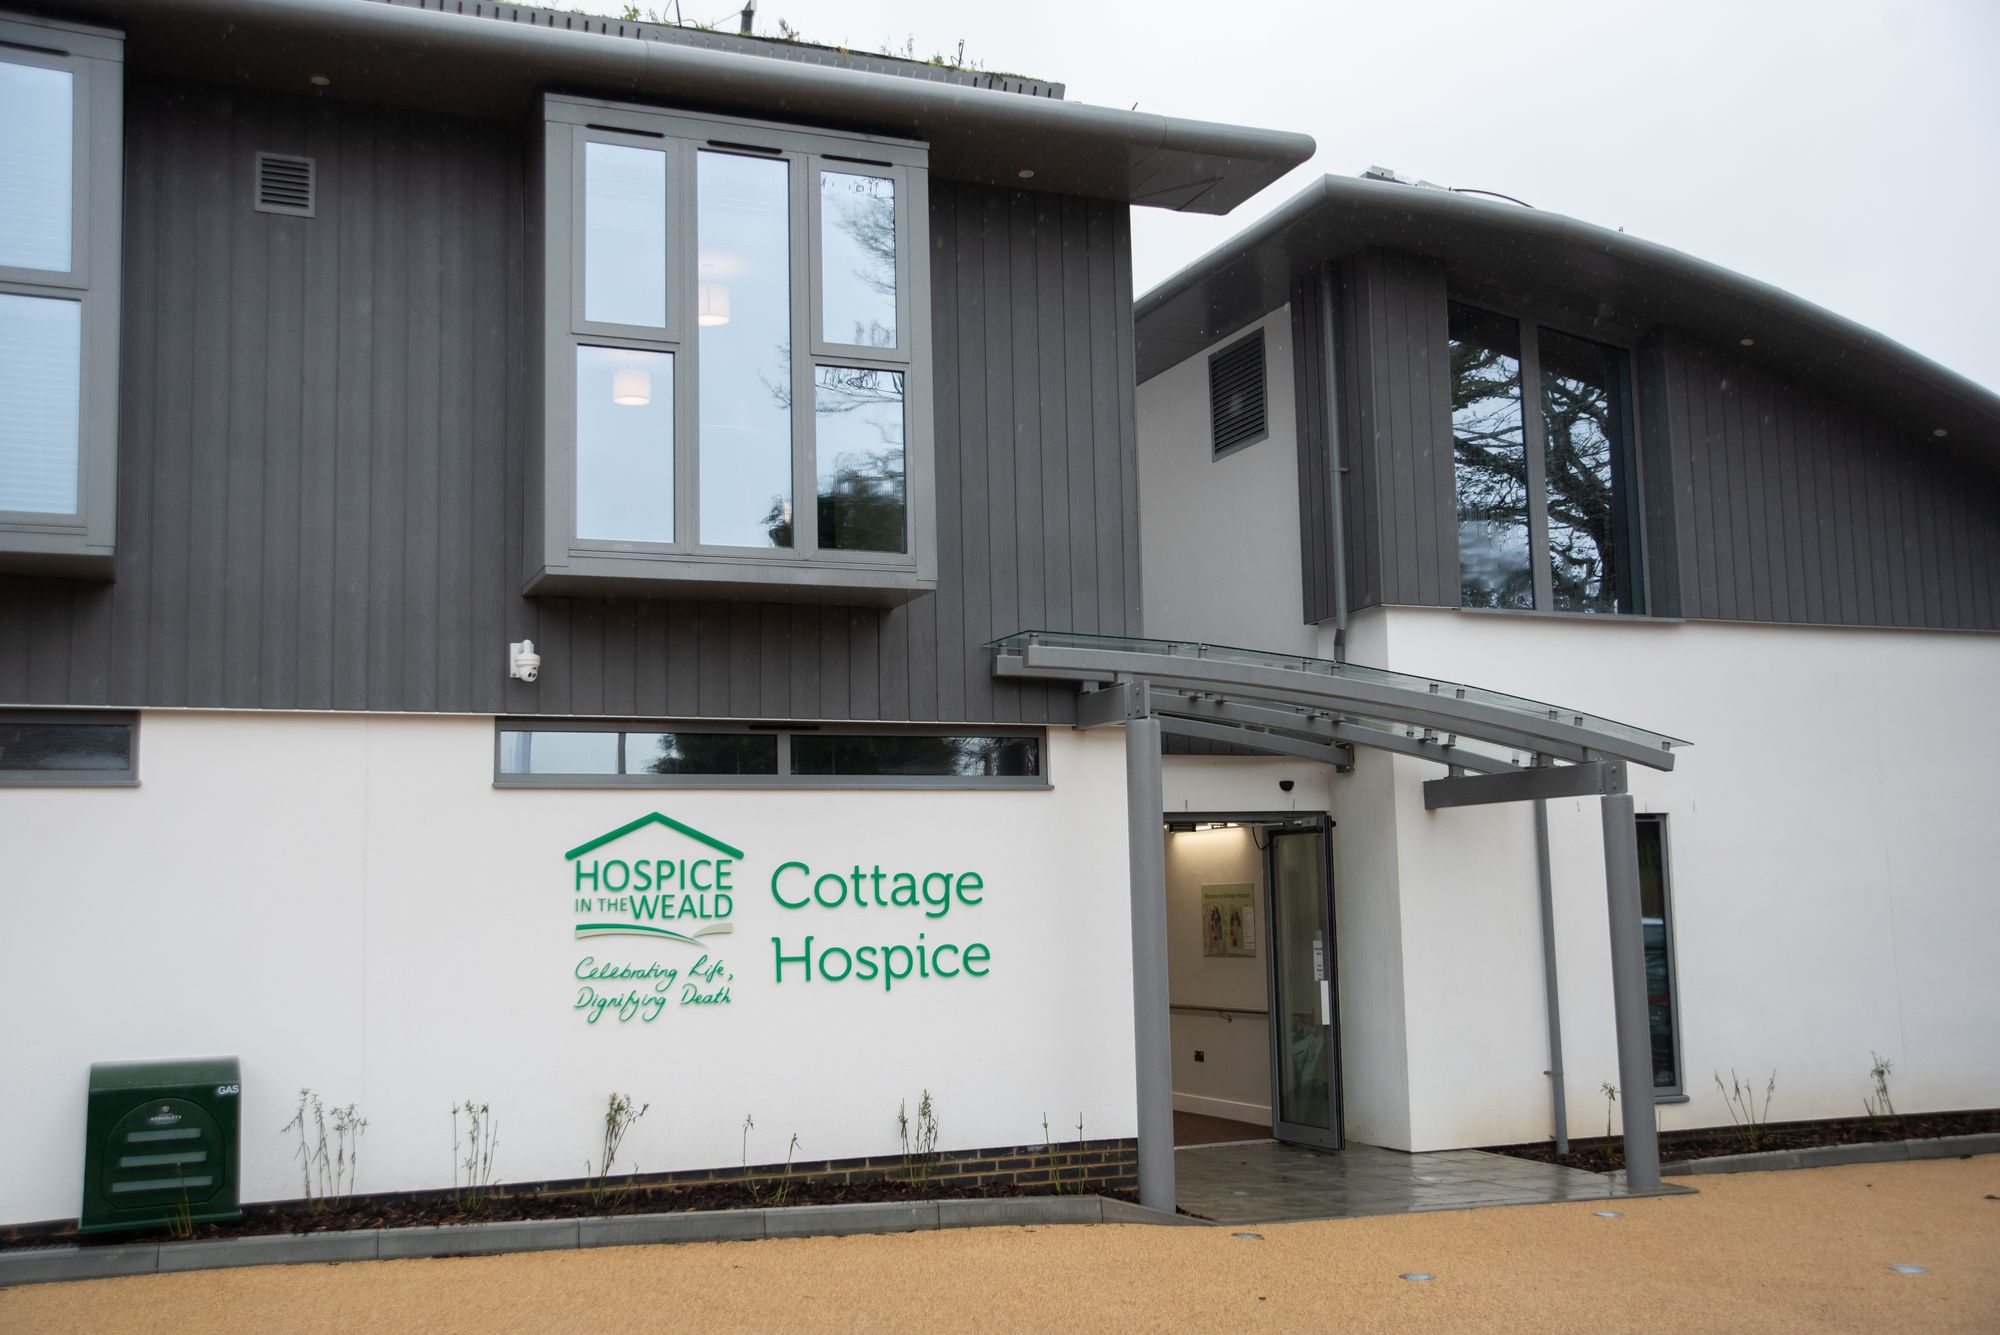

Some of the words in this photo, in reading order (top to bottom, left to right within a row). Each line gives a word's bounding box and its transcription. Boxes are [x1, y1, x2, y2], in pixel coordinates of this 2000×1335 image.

[575, 858, 734, 893] HOSPICE
[770, 861, 985, 919] Cottage
[575, 898, 592, 912] IN
[597, 897, 628, 912] THE
[629, 893, 734, 920] WEALD
[575, 956, 678, 992] Celebrating
[688, 954, 734, 984] Life,
[770, 933, 992, 992] Hospice
[573, 986, 667, 1025] Dignifying
[680, 983, 732, 1005] Death
[218, 1084, 240, 1095] GAS
